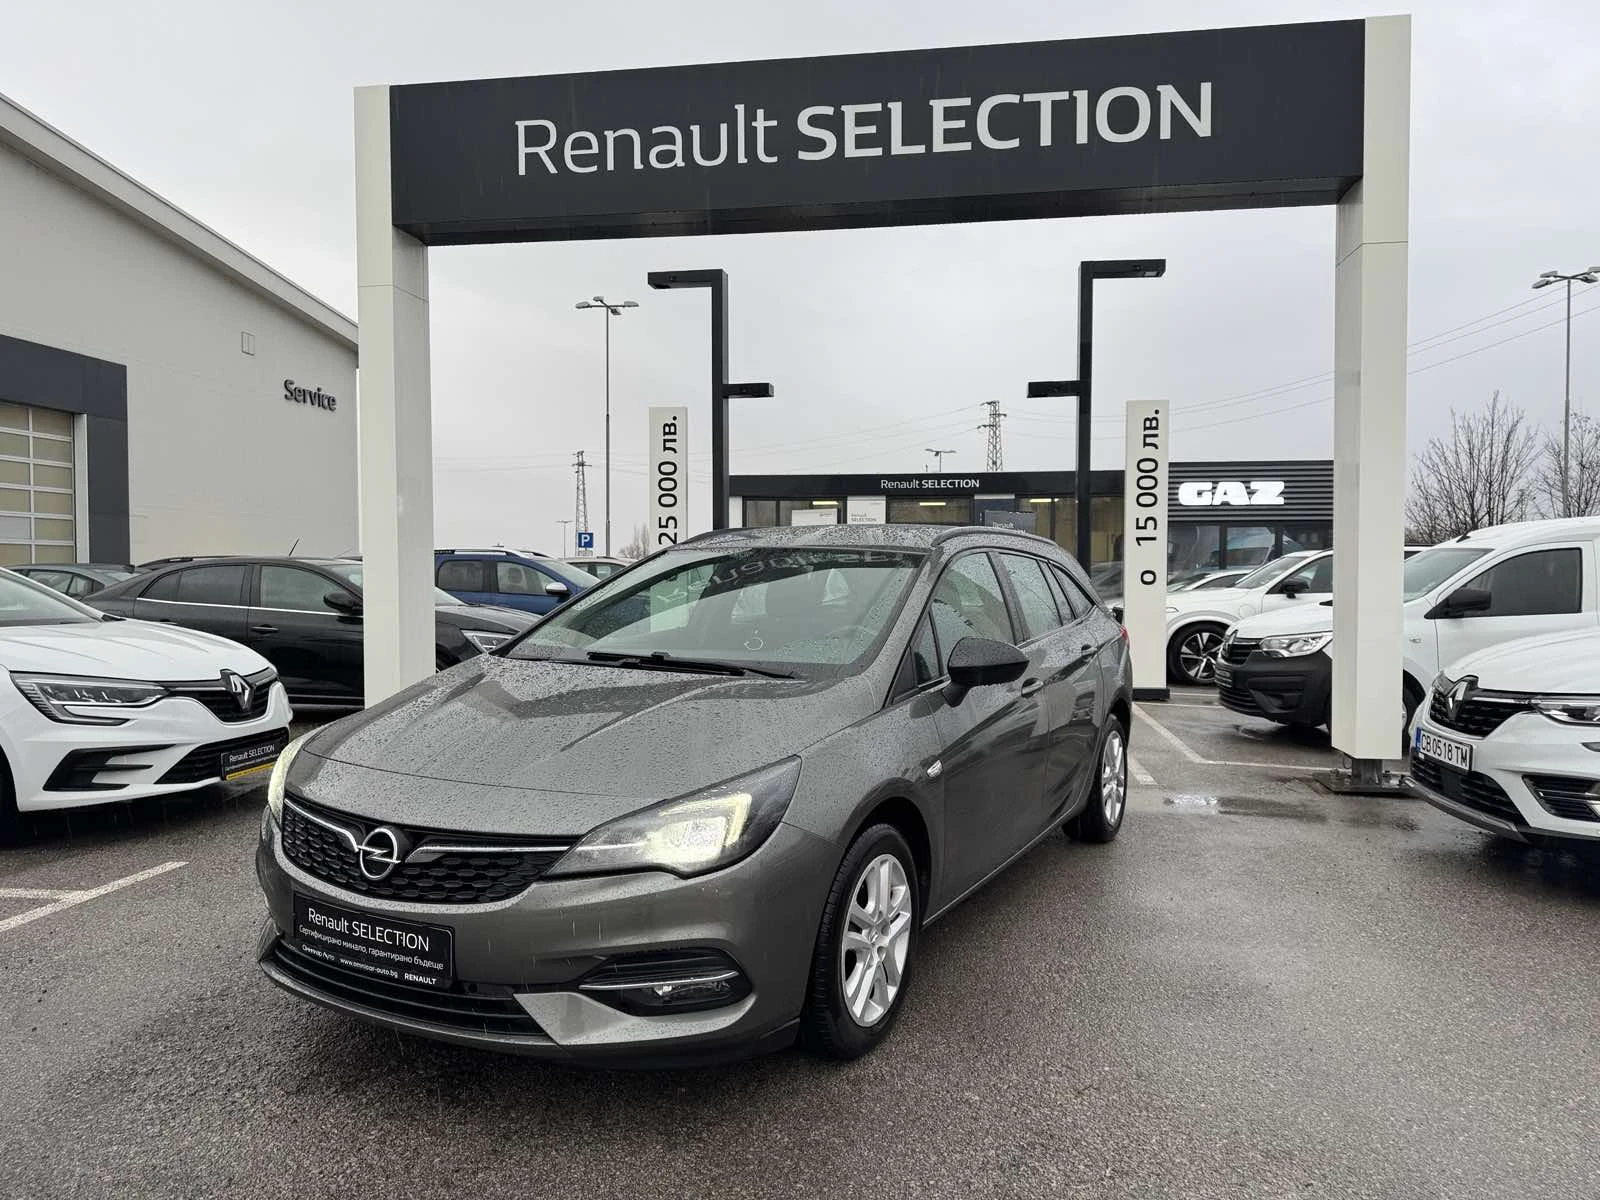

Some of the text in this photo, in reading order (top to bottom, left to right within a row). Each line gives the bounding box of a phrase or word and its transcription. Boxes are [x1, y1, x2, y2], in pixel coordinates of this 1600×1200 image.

[514, 81, 1212, 176] Renault SELECTION
[283, 379, 337, 412] Service
[1143, 409, 1160, 450] лв.
[657, 415, 678, 545] 25 000 лв.
[880, 478, 980, 489] Renault SELECTION
[1136, 457, 1159, 508] 000
[1178, 481, 1285, 506] GAZ
[581, 534, 590, 547] P
[1135, 516, 1158, 547] 15
[248, 744, 275, 758] SELECTION
[308, 907, 429, 952] Renault SELECTION
[299, 924, 444, 971] Сертифицирано минало, гарантирано бъдеще
[404, 972, 437, 985] RENAULT
